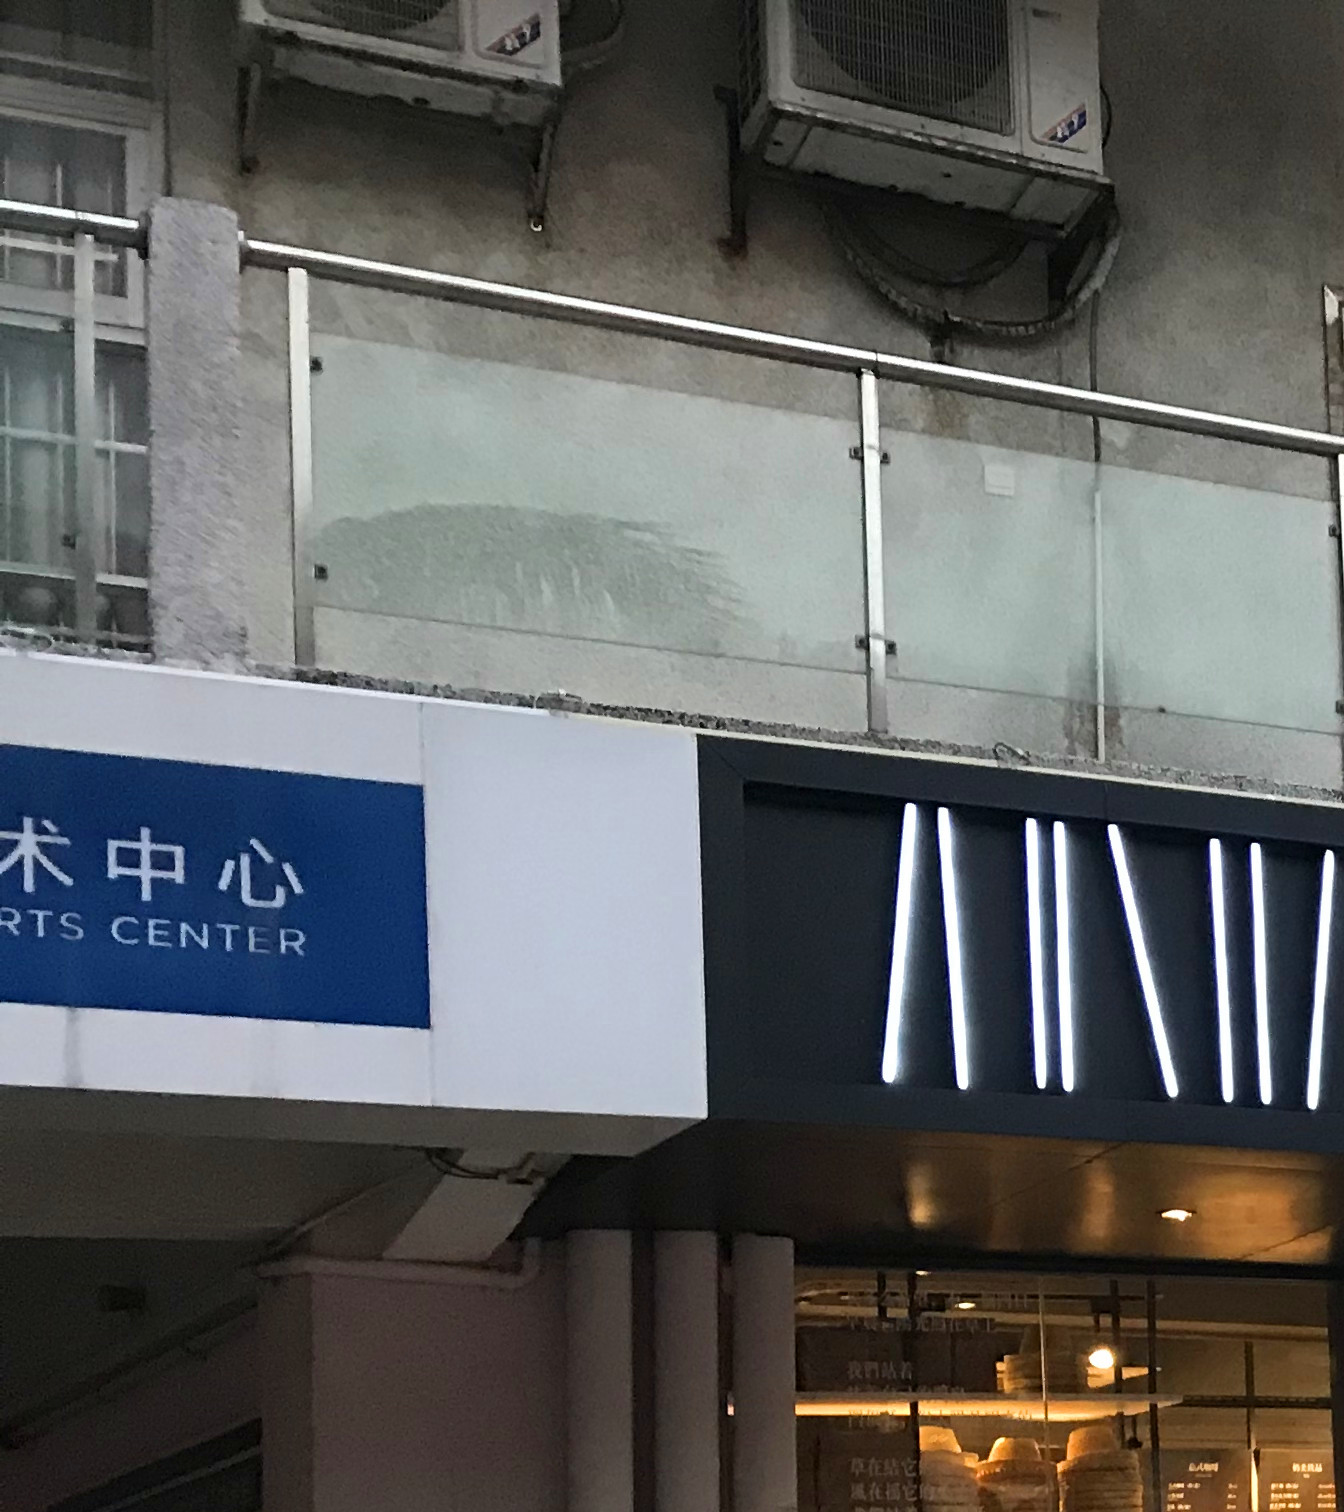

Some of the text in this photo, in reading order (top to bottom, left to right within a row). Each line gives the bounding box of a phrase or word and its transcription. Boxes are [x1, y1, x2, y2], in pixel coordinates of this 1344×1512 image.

[0, 816, 305, 909] 术中心
[111, 916, 306, 956] CENTER
